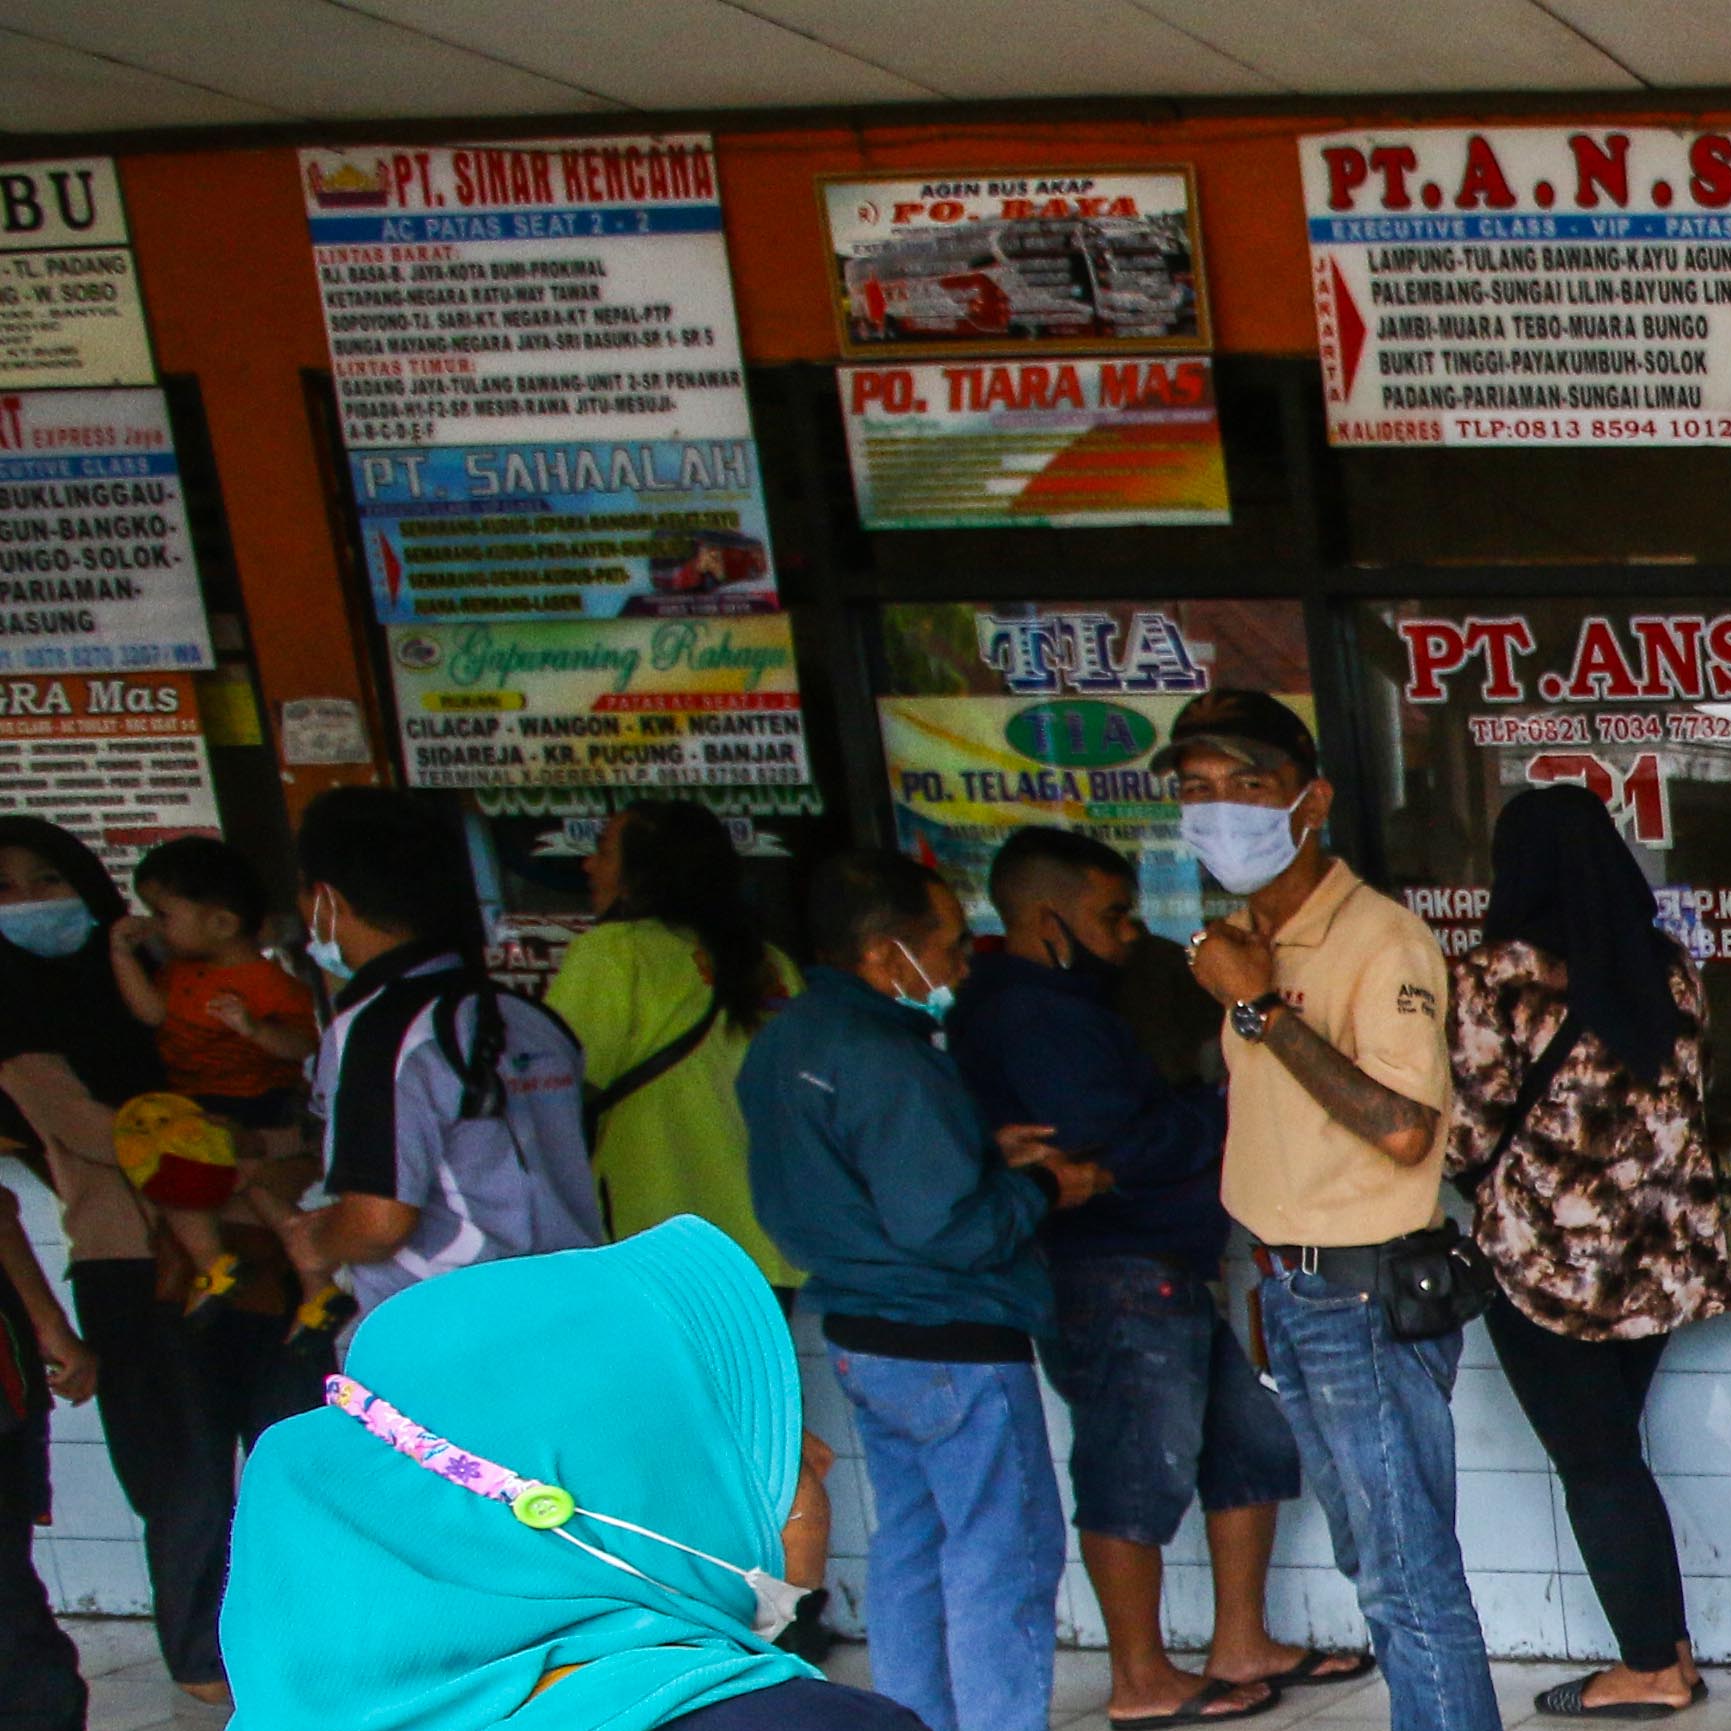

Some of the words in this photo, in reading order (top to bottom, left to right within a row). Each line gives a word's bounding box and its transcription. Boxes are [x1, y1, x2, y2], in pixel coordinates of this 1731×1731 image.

[397, 154, 445, 208] PT.
[453, 150, 554, 207] SINAR
[561, 142, 717, 201] KENCANA
[921, 181, 981, 201] AGEN
[987, 181, 1028, 198] BUS
[1035, 179, 1094, 196] AKAP
[891, 201, 981, 225] PO.
[1000, 196, 1139, 220] RAYA
[426, 217, 499, 240] PATAS
[514, 214, 577, 237] SEAT
[1331, 219, 1467, 241] EXECUTIVE
[1478, 218, 1558, 238] CLASS
[1593, 218, 1631, 237] VIP
[1643, 315, 1709, 338] BUNGO
[1379, 350, 1435, 376] BUKIT
[851, 370, 928, 416] PO.
[942, 366, 1085, 413] TIARA
[1100, 362, 1208, 410] MAS
[1644, 385, 1701, 409] LIMAU
[33, 426, 115, 448] EXPRESS
[1455, 420, 1581, 440] TLP:0813
[1591, 420, 1658, 438] 8594
[361, 453, 449, 499] PT.
[465, 442, 750, 496] SAHAALAH
[975, 611, 1209, 695] TIA
[86, 680, 180, 714] Mas
[406, 717, 501, 741] CILACAP
[518, 714, 620, 737] WANGON
[640, 715, 681, 736] KW.
[688, 714, 801, 735] NGANTEN
[1019, 712, 1138, 755] TIA
[1471, 718, 1590, 745] TLP:0821
[1600, 718, 1662, 743] 7034
[1669, 716, 1731, 741] 7732
[416, 745, 524, 767] SIDAREJA
[544, 745, 581, 766] KR.
[588, 743, 685, 765] PUCUNG
[703, 742, 796, 764] BANJAR
[904, 771, 952, 801] PO.
[962, 771, 1078, 802] TELAGA
